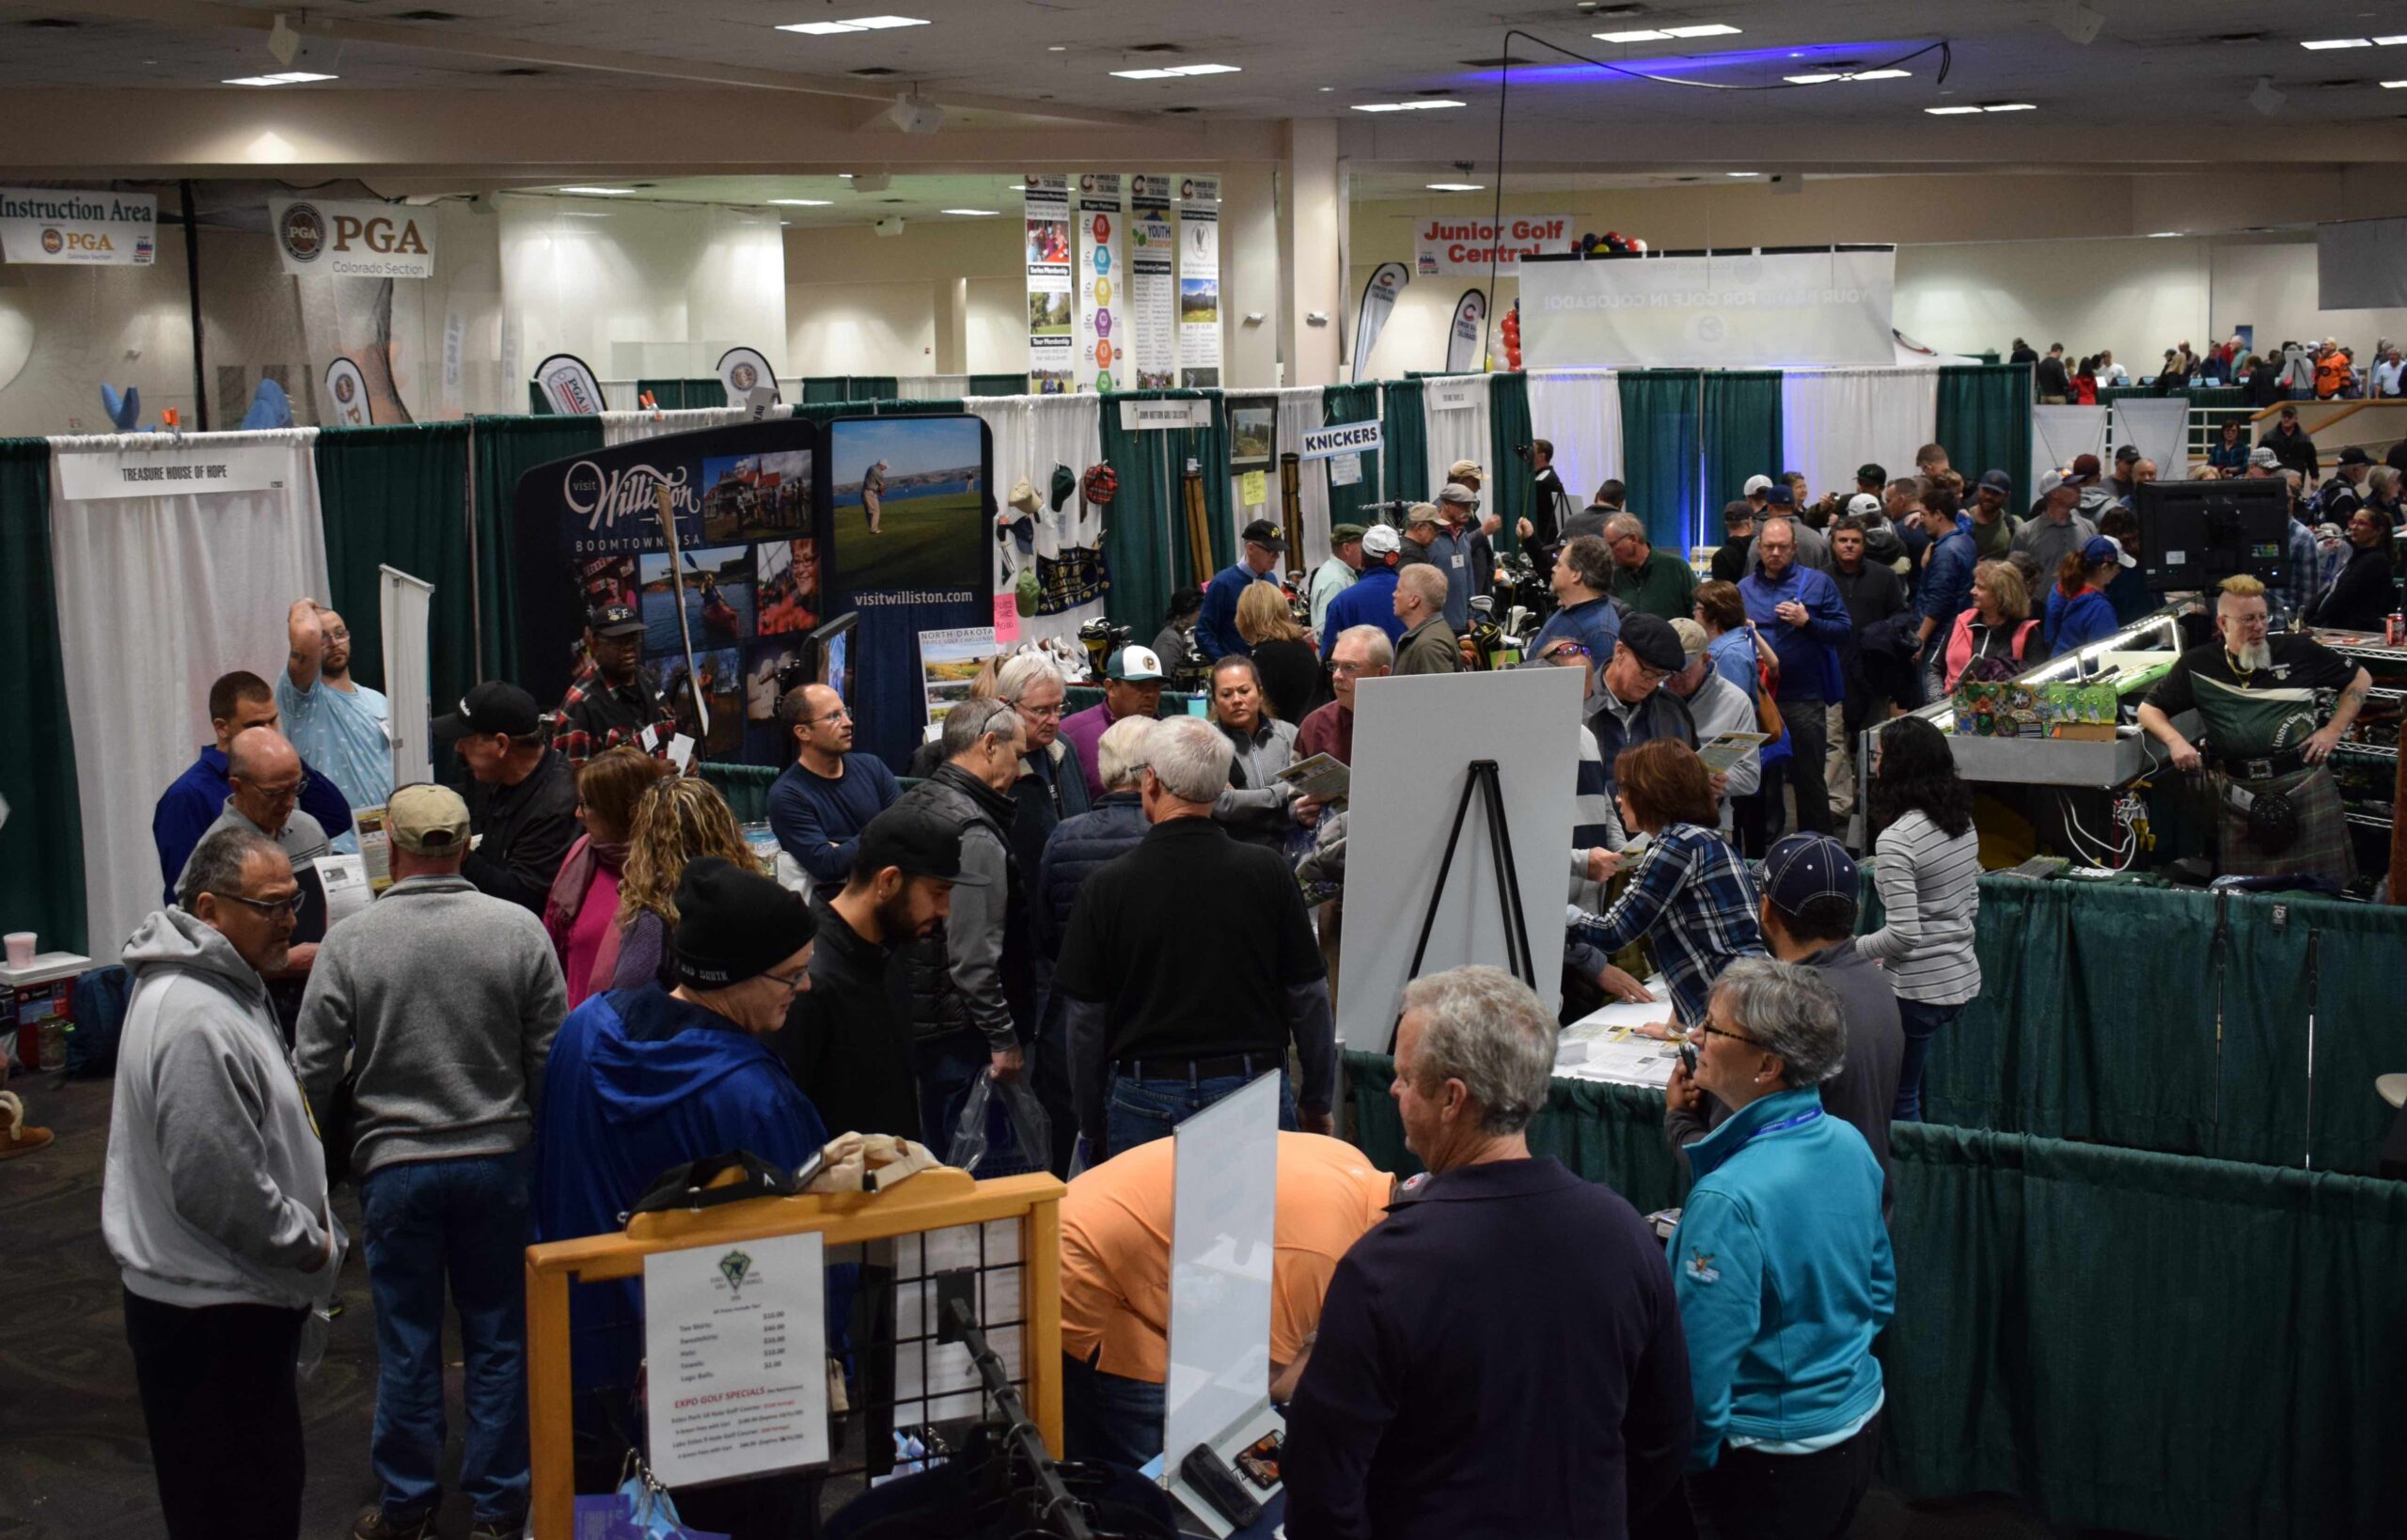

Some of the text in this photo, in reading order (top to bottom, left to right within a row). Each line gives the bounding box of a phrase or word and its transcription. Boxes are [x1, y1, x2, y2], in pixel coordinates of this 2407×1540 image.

[0, 194, 152, 222] Instruction Area
[290, 227, 317, 239] PGA
[333, 215, 428, 254] PGA
[1147, 226, 1171, 238] YOUTH
[1424, 220, 1565, 241] Junior Golf
[67, 233, 114, 251] PGA
[333, 261, 424, 275] Colorado Section
[568, 378, 586, 403] PGA
[1305, 427, 1377, 451] KNICKERS
[122, 464, 228, 481] TREASURE HOUSE OF HOPE
[573, 480, 596, 491] visit
[575, 538, 664, 552] BOOMTOWN
[855, 590, 973, 606] visitwilliston.com
[956, 628, 993, 637] DAKOTA
[675, 1397, 698, 1408] EXPO
[700, 1393, 724, 1405] GOLF
[726, 1386, 765, 1400] SPECIALS
